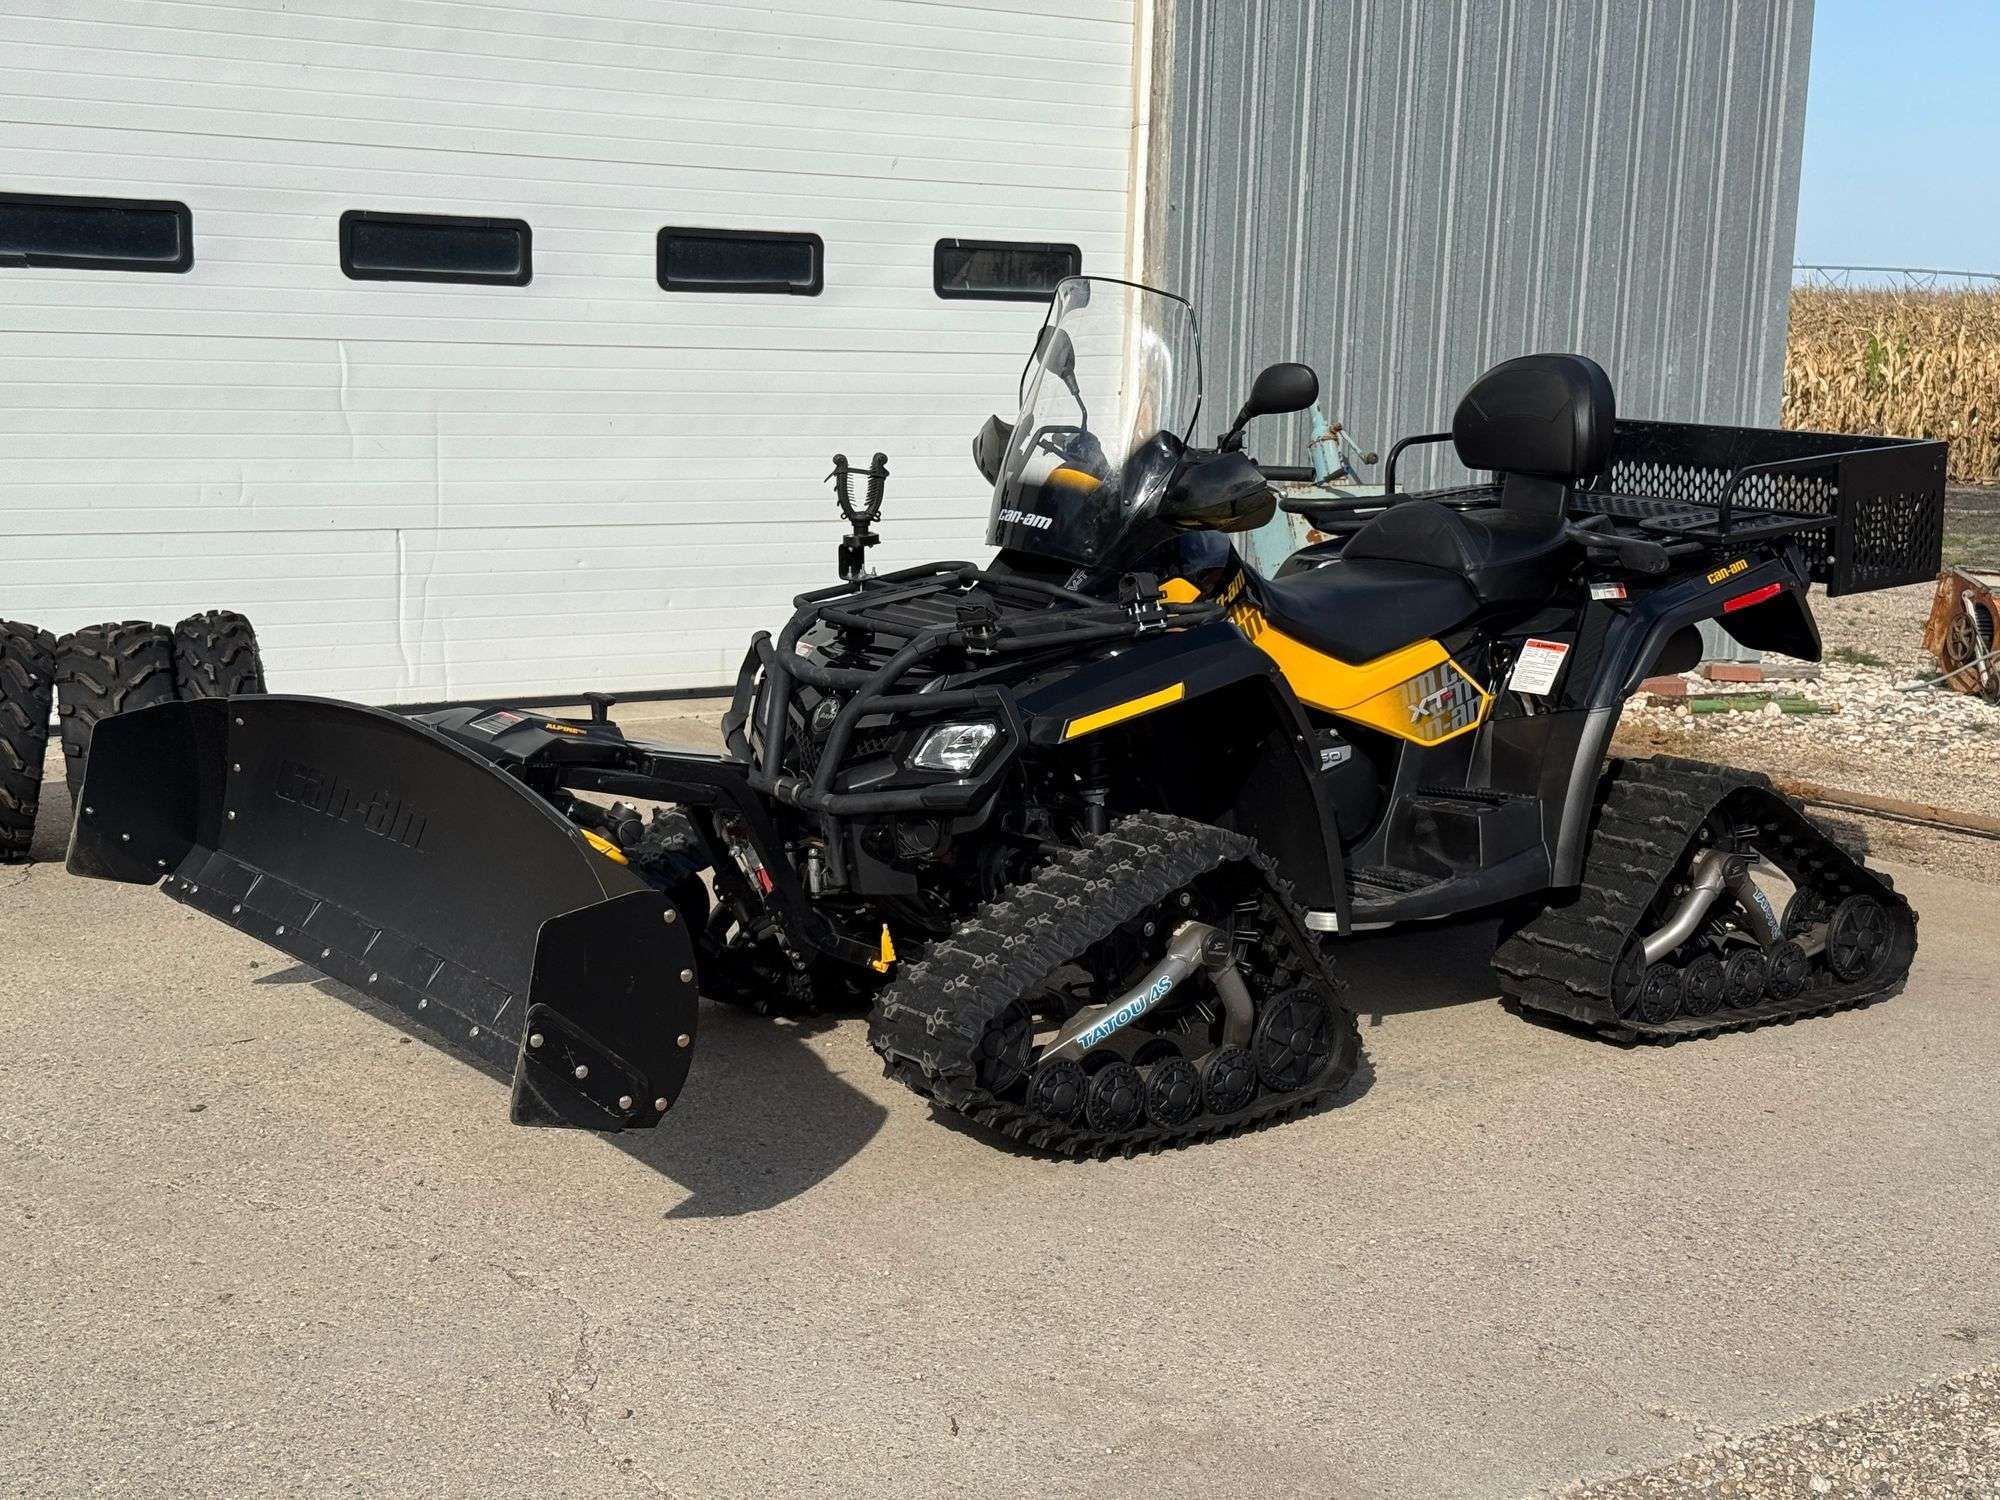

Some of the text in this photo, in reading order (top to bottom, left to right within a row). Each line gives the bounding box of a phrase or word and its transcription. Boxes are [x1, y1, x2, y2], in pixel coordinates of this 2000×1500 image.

[999, 508, 1053, 530] can-am
[1707, 559, 1748, 584] can-am
[1215, 568, 1246, 607] n-am
[545, 722, 578, 735] ALPINE
[1077, 975, 1173, 1050] TATOU 4S
